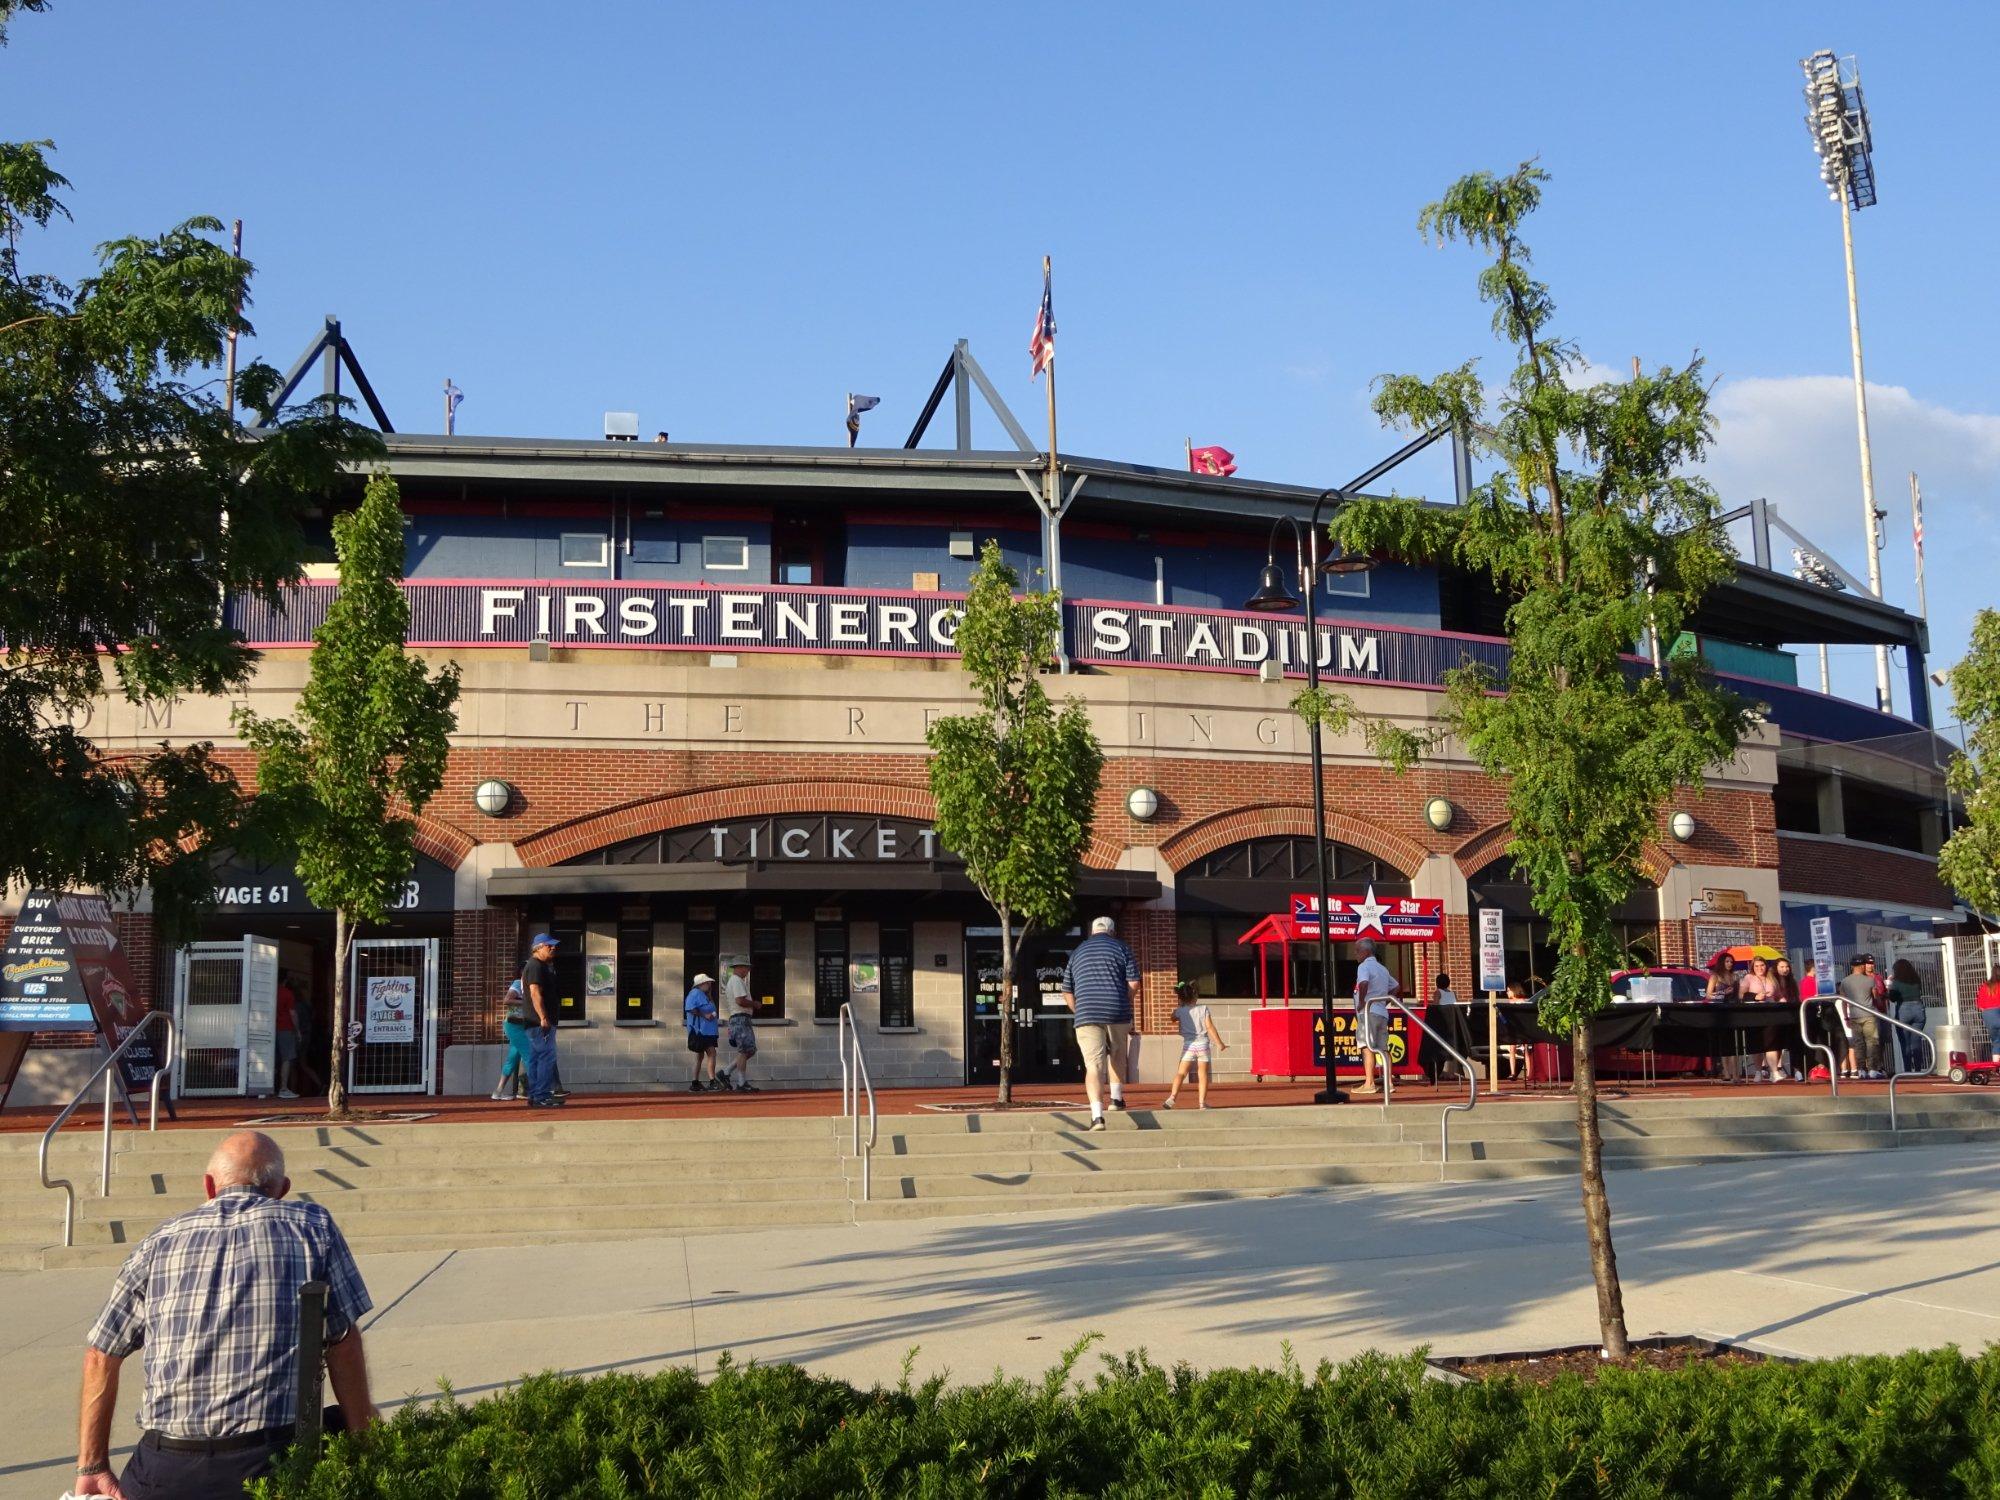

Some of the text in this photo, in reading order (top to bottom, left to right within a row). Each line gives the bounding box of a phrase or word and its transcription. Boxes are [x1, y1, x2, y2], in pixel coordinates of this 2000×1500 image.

[480, 588, 1379, 672] FIRSTENERG STADIUM
[566, 701, 744, 733] THE
[269, 885, 289, 903] 61
[27, 898, 52, 909] BUY
[1310, 897, 1421, 914] Wite Star
[34, 913, 42, 922] A
[74, 926, 108, 945] TICKETS
[1301, 926, 1321, 934] GROU
[1389, 928, 1434, 937] INFORMATION
[21, 935, 54, 945] BRICK
[3, 957, 70, 981] Baseballtown
[370, 980, 412, 1000] Fightins
[980, 982, 995, 991] FRONT
[1039, 982, 1054, 991] FRONT
[373, 1025, 406, 1033] ENTRANCE
